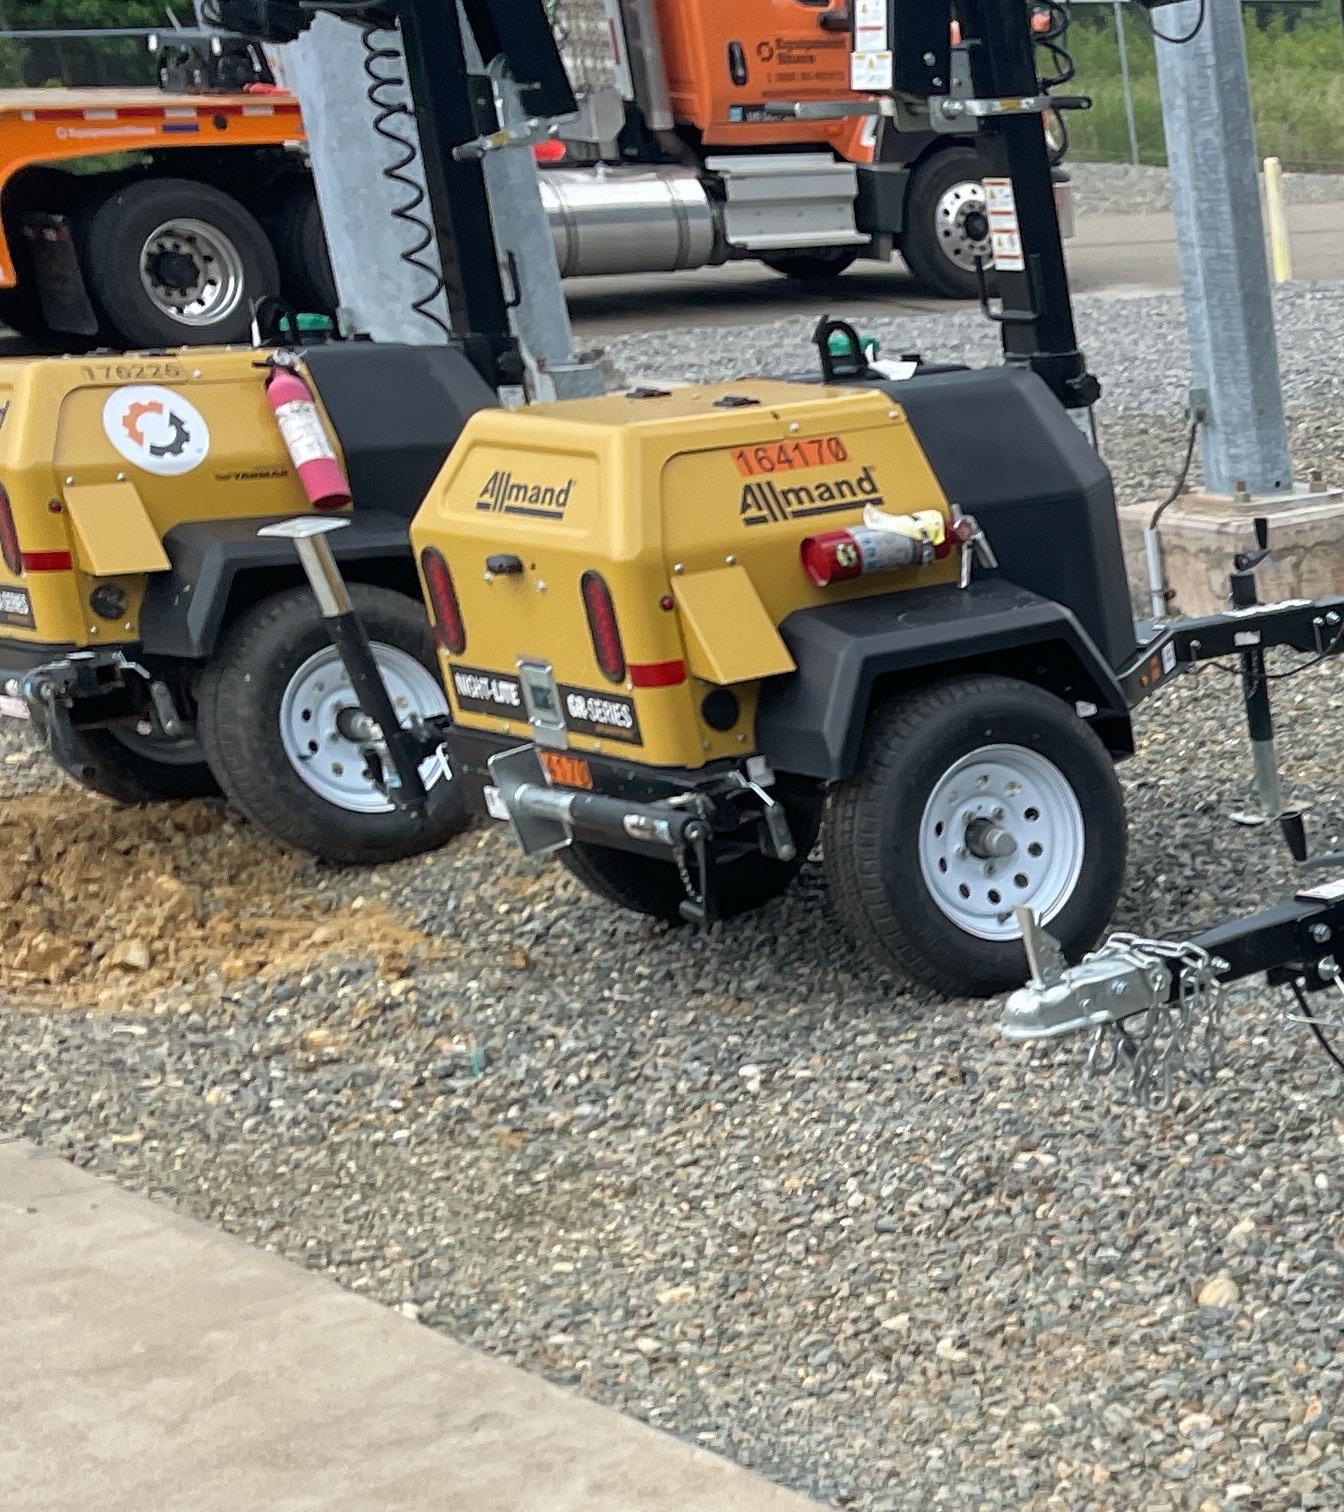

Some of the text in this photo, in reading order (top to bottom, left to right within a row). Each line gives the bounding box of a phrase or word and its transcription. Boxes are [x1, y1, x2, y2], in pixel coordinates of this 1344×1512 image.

[736, 436, 848, 474] 164170
[477, 471, 573, 514] Allmand
[739, 465, 878, 522] Allmand
